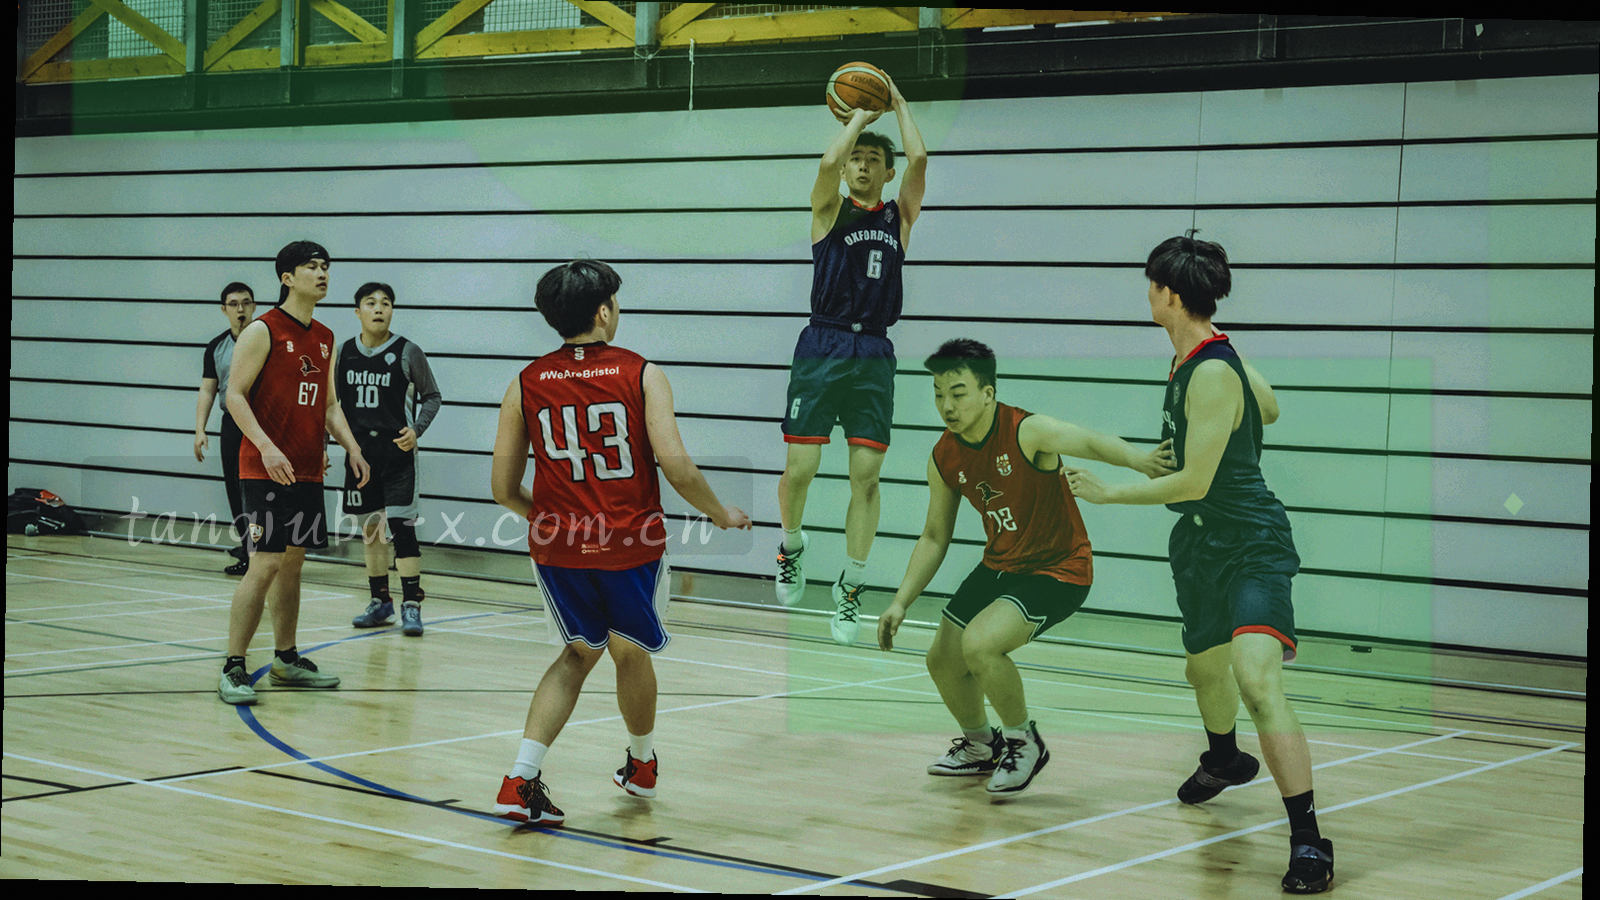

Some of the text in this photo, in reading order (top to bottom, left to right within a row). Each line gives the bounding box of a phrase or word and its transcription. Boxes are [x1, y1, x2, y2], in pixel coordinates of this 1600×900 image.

[866, 249, 883, 280] 6
[346, 369, 391, 387] Oxford
[539, 366, 620, 381] #WeAreBristol
[298, 382, 319, 406] 67
[355, 385, 379, 408] 10
[790, 398, 801, 420] 6
[536, 401, 635, 483] 43
[346, 490, 362, 506] 10
[986, 507, 1018, 533] 72
